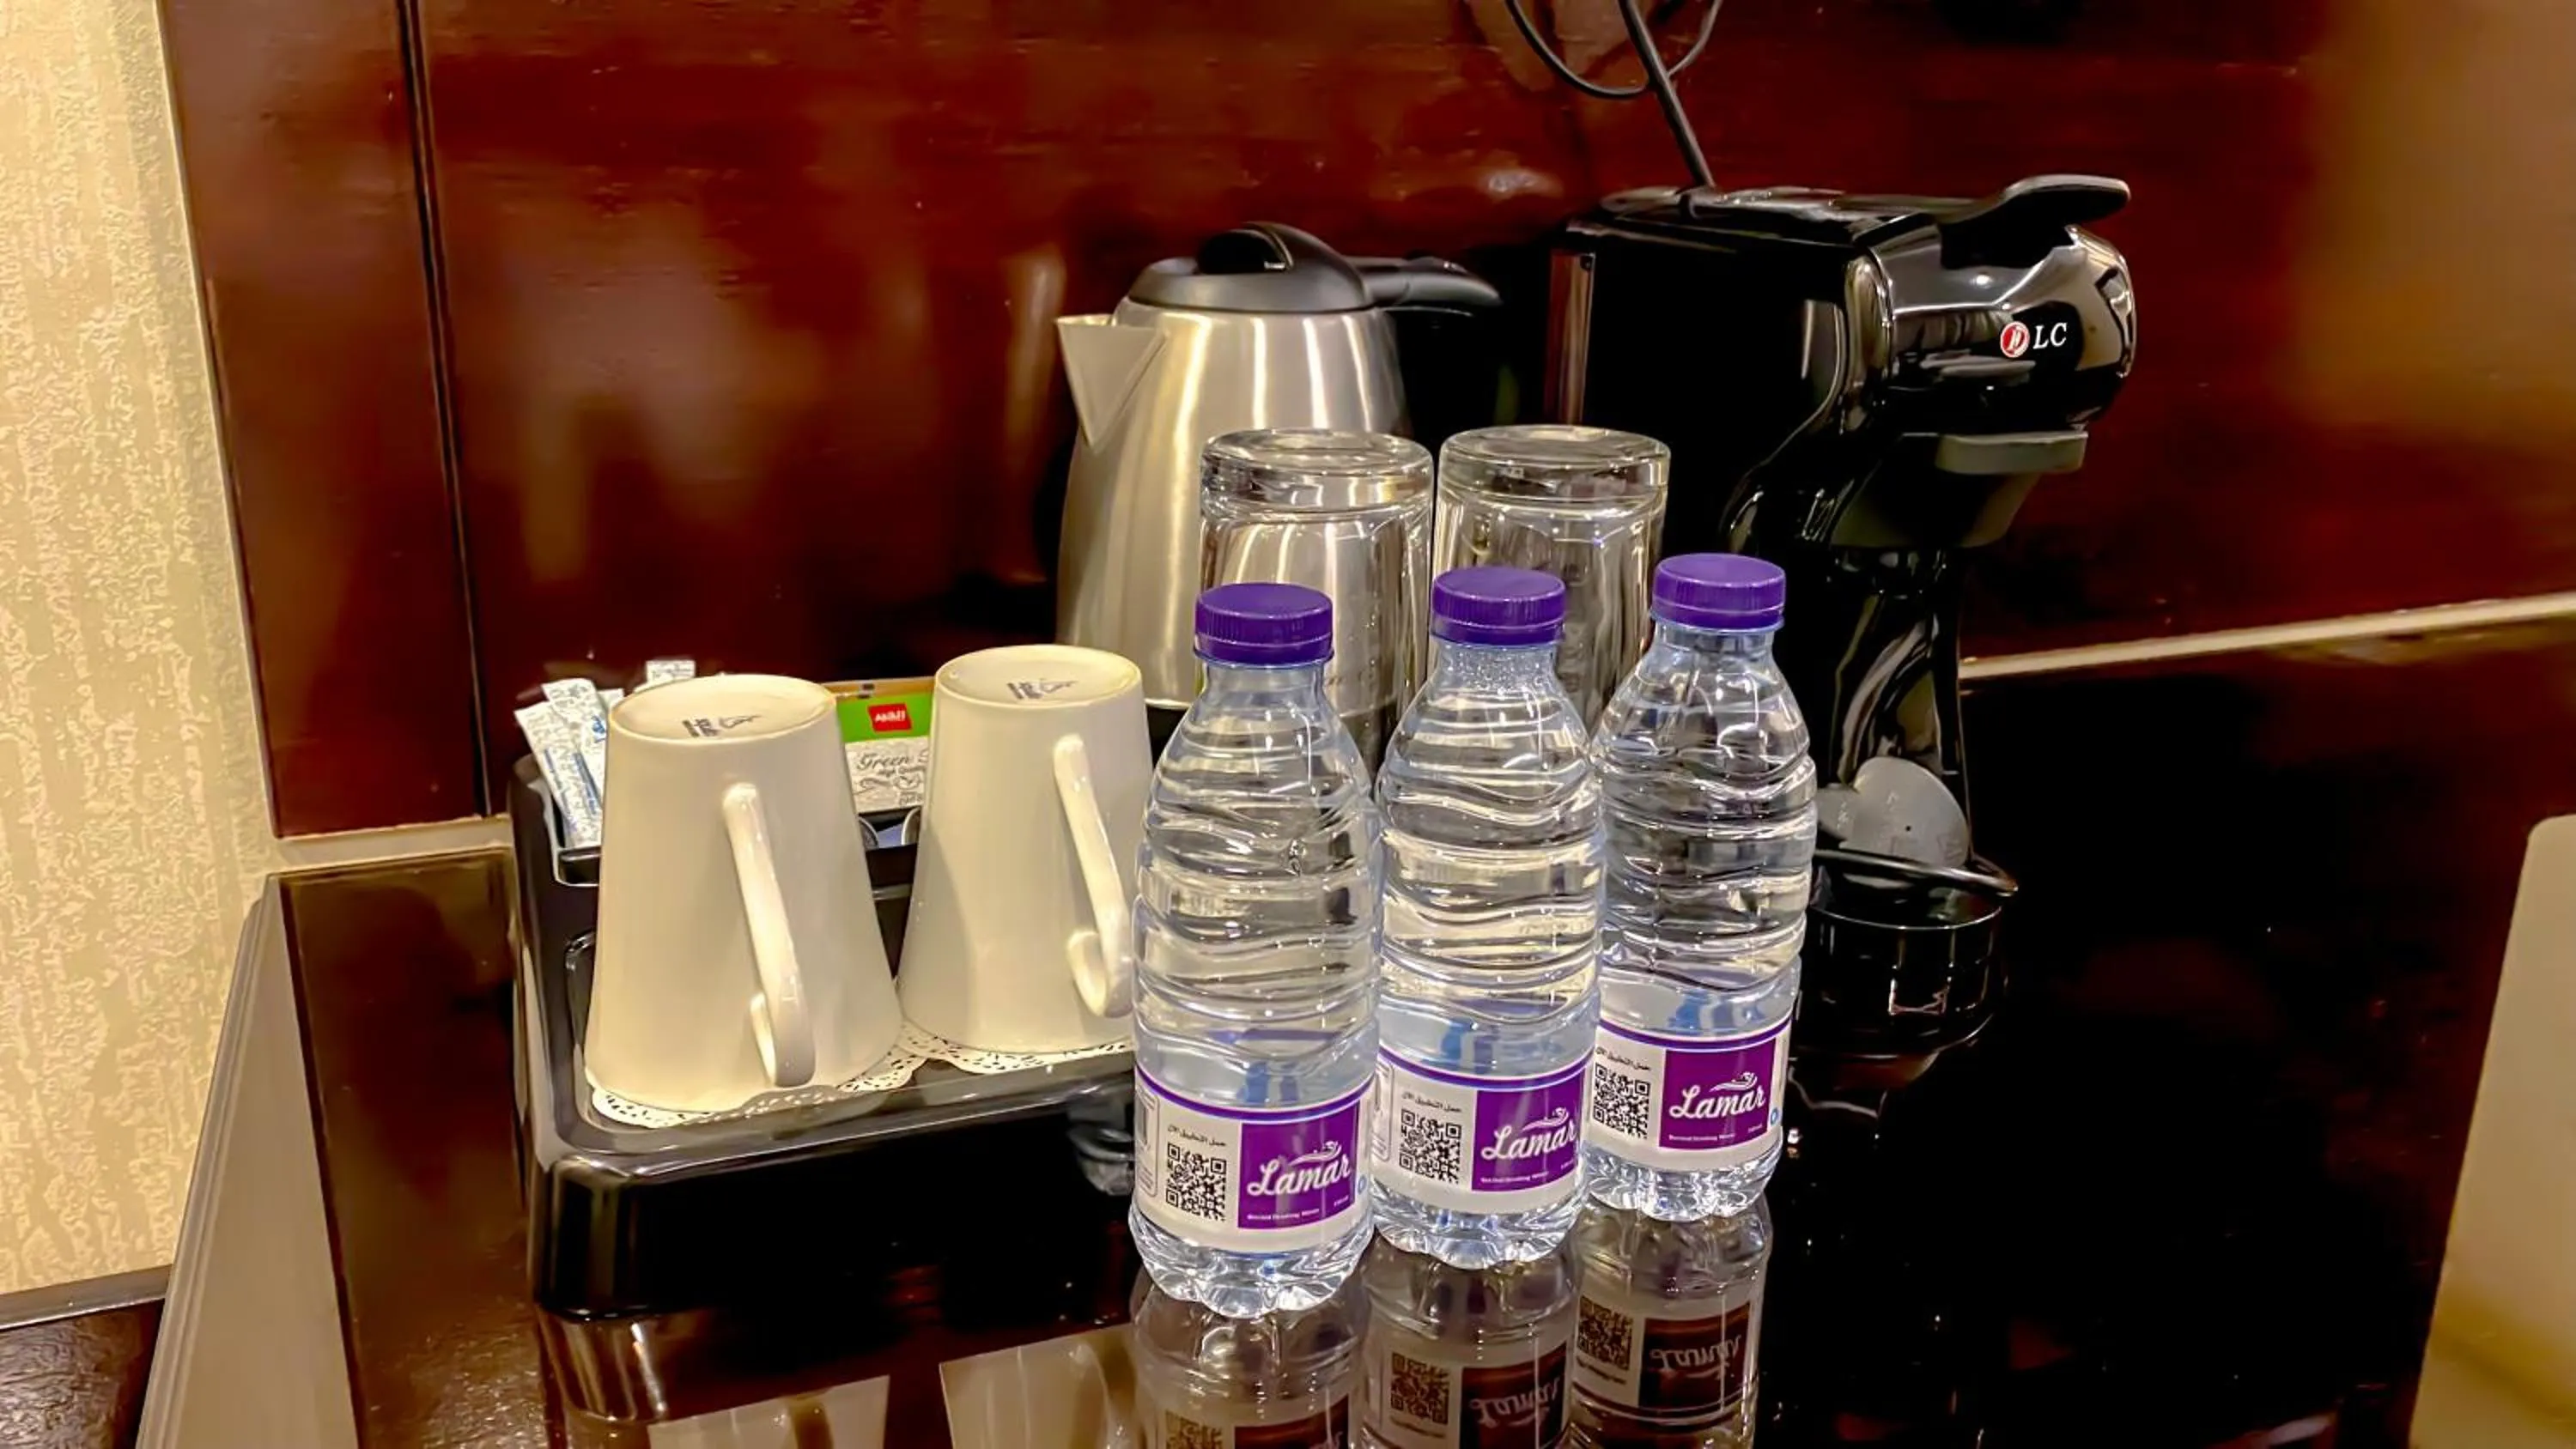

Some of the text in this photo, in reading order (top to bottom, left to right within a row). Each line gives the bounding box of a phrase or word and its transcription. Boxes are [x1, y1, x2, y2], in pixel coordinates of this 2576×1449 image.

[1668, 1084, 1766, 1119] Lamar
[1480, 1119, 1577, 1160] Lamar
[1247, 1153, 1352, 1197] Lamar
